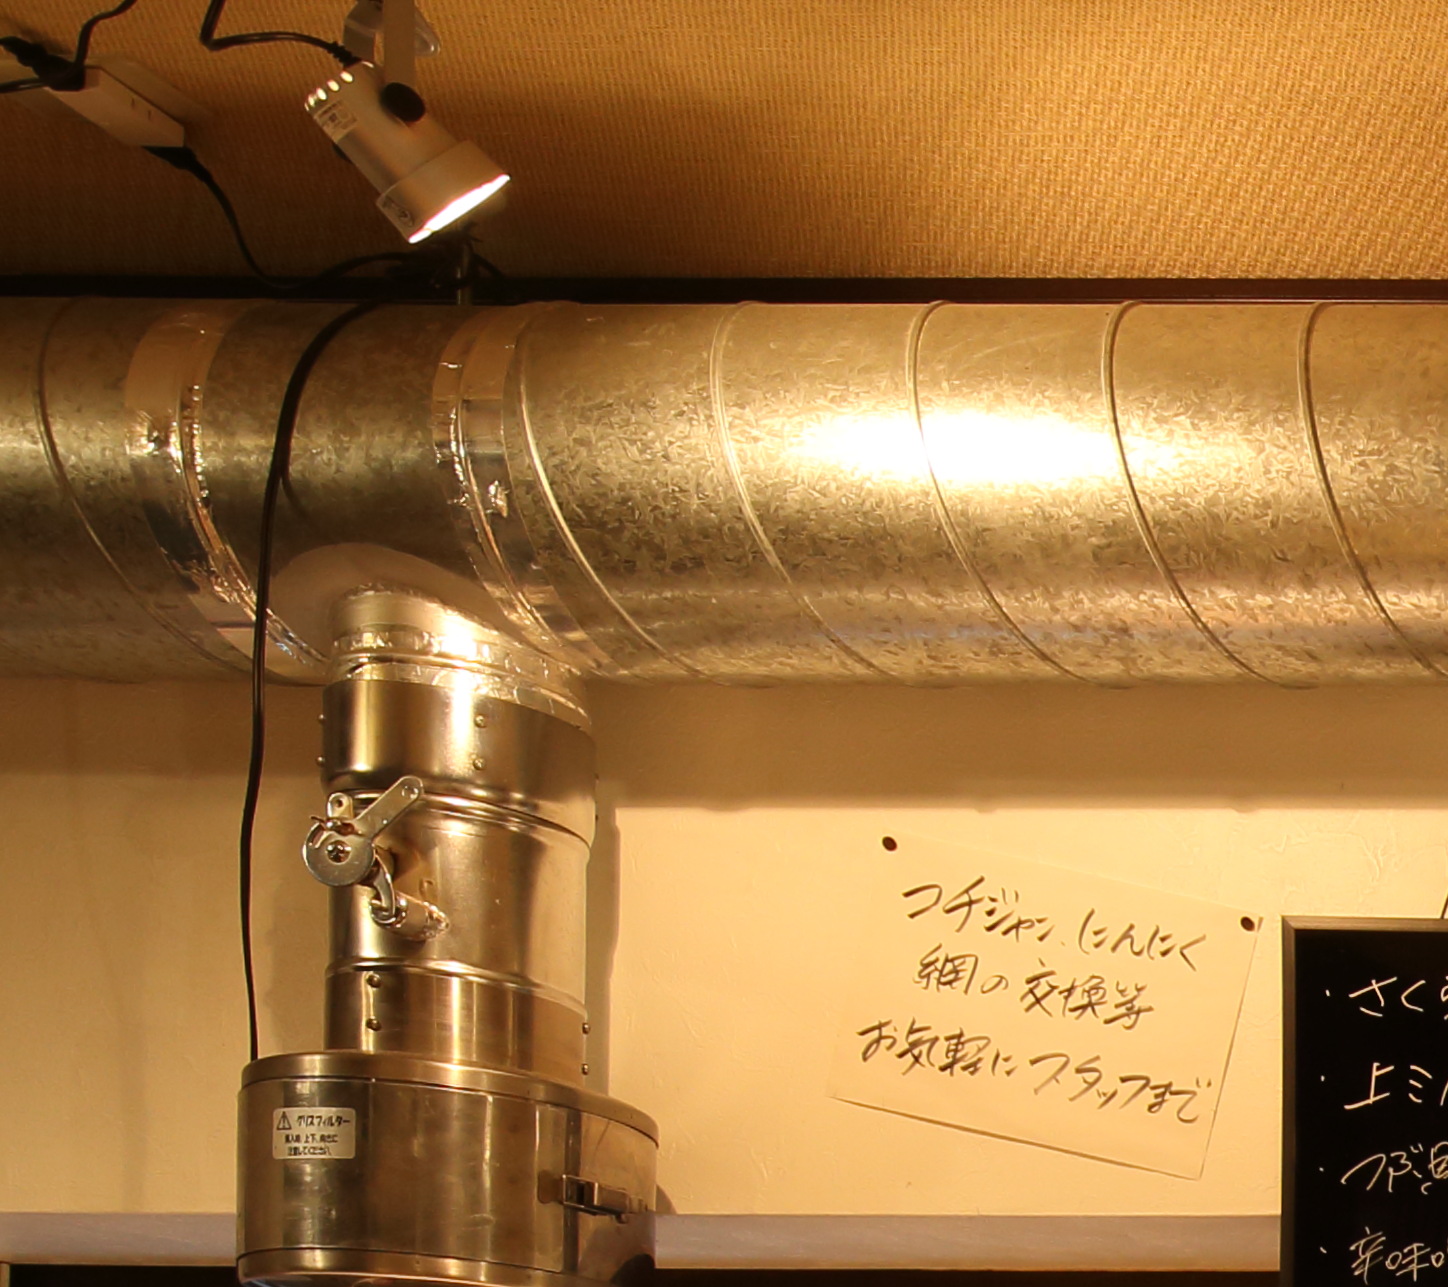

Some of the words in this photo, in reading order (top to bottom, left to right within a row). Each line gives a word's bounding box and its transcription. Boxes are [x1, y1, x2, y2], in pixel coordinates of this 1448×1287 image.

[856, 1018, 1213, 1124] お気軽にスタッフまで
